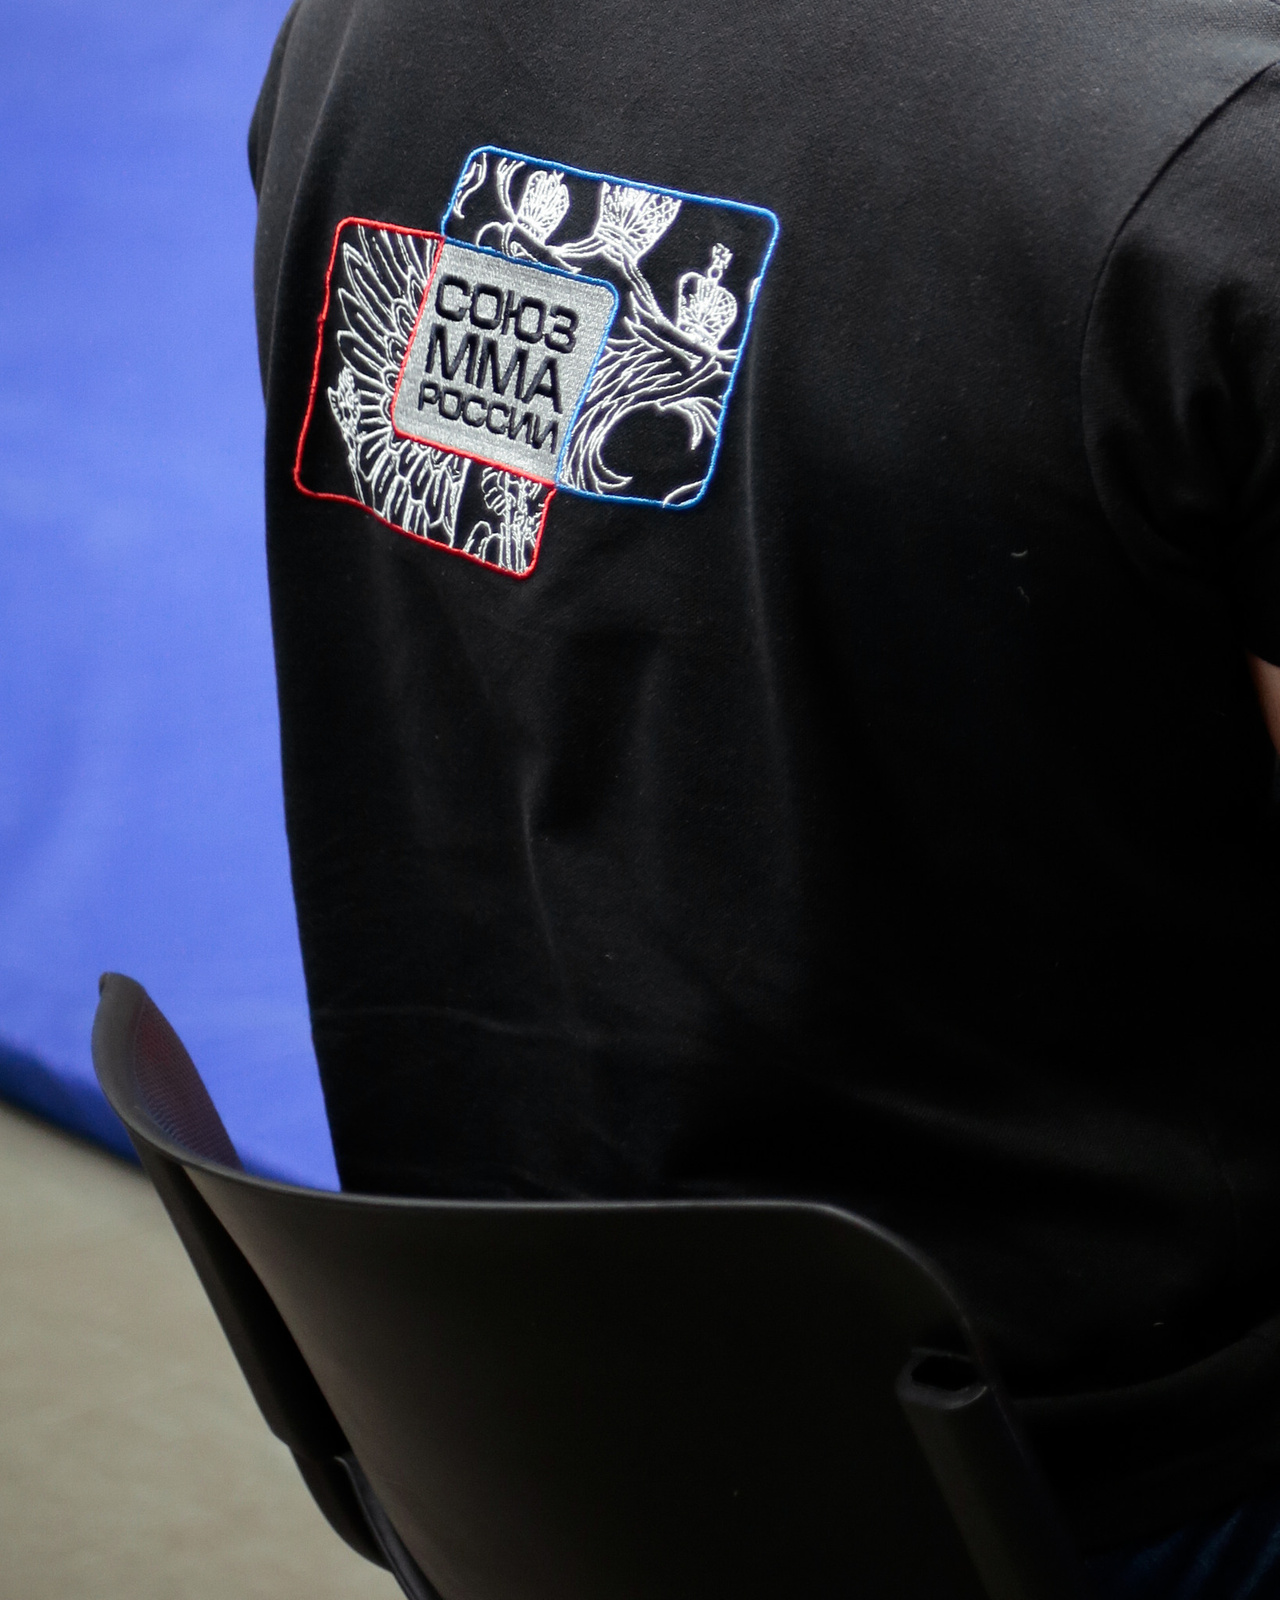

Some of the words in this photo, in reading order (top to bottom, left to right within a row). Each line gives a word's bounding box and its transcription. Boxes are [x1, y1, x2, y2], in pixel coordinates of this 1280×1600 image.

[435, 275, 579, 354] СОЮЗ
[425, 324, 562, 414] ММА
[418, 381, 559, 454] РОССИИ
